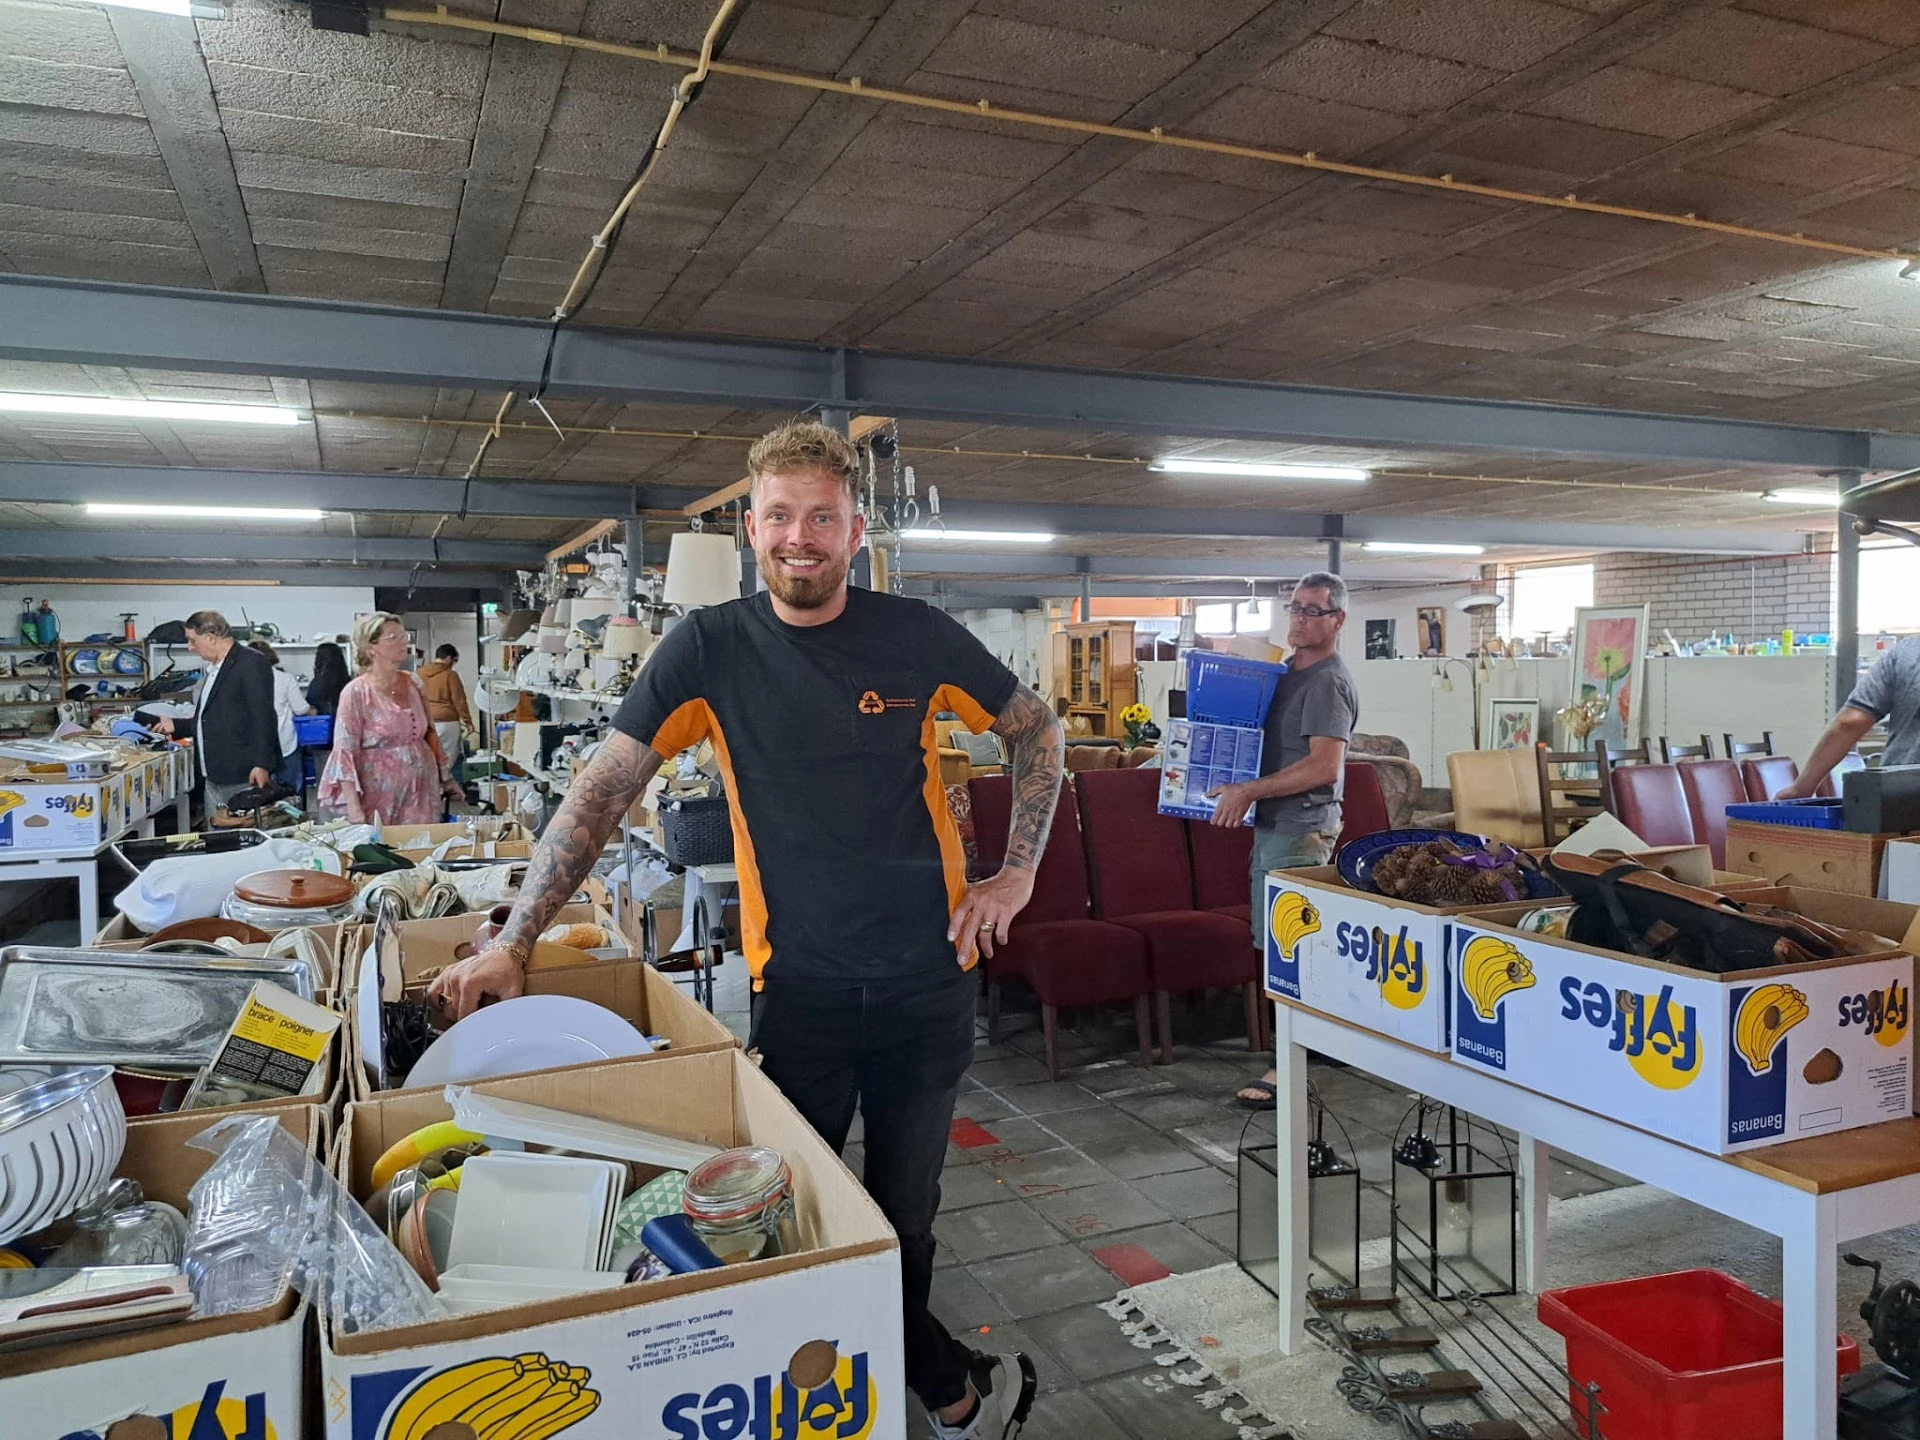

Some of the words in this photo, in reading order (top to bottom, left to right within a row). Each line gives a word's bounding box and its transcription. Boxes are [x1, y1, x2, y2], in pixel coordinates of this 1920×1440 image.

[1336, 921, 1423, 993] fyffes
[1269, 974, 1300, 996] Bananas
[248, 1007, 275, 1023] brace
[1838, 979, 1909, 1036] fyffes
[279, 1018, 315, 1037] poignet
[1559, 975, 1697, 1072] fyffes
[1458, 1036, 1504, 1065] Bananas
[1731, 1113, 1783, 1134] Bananas
